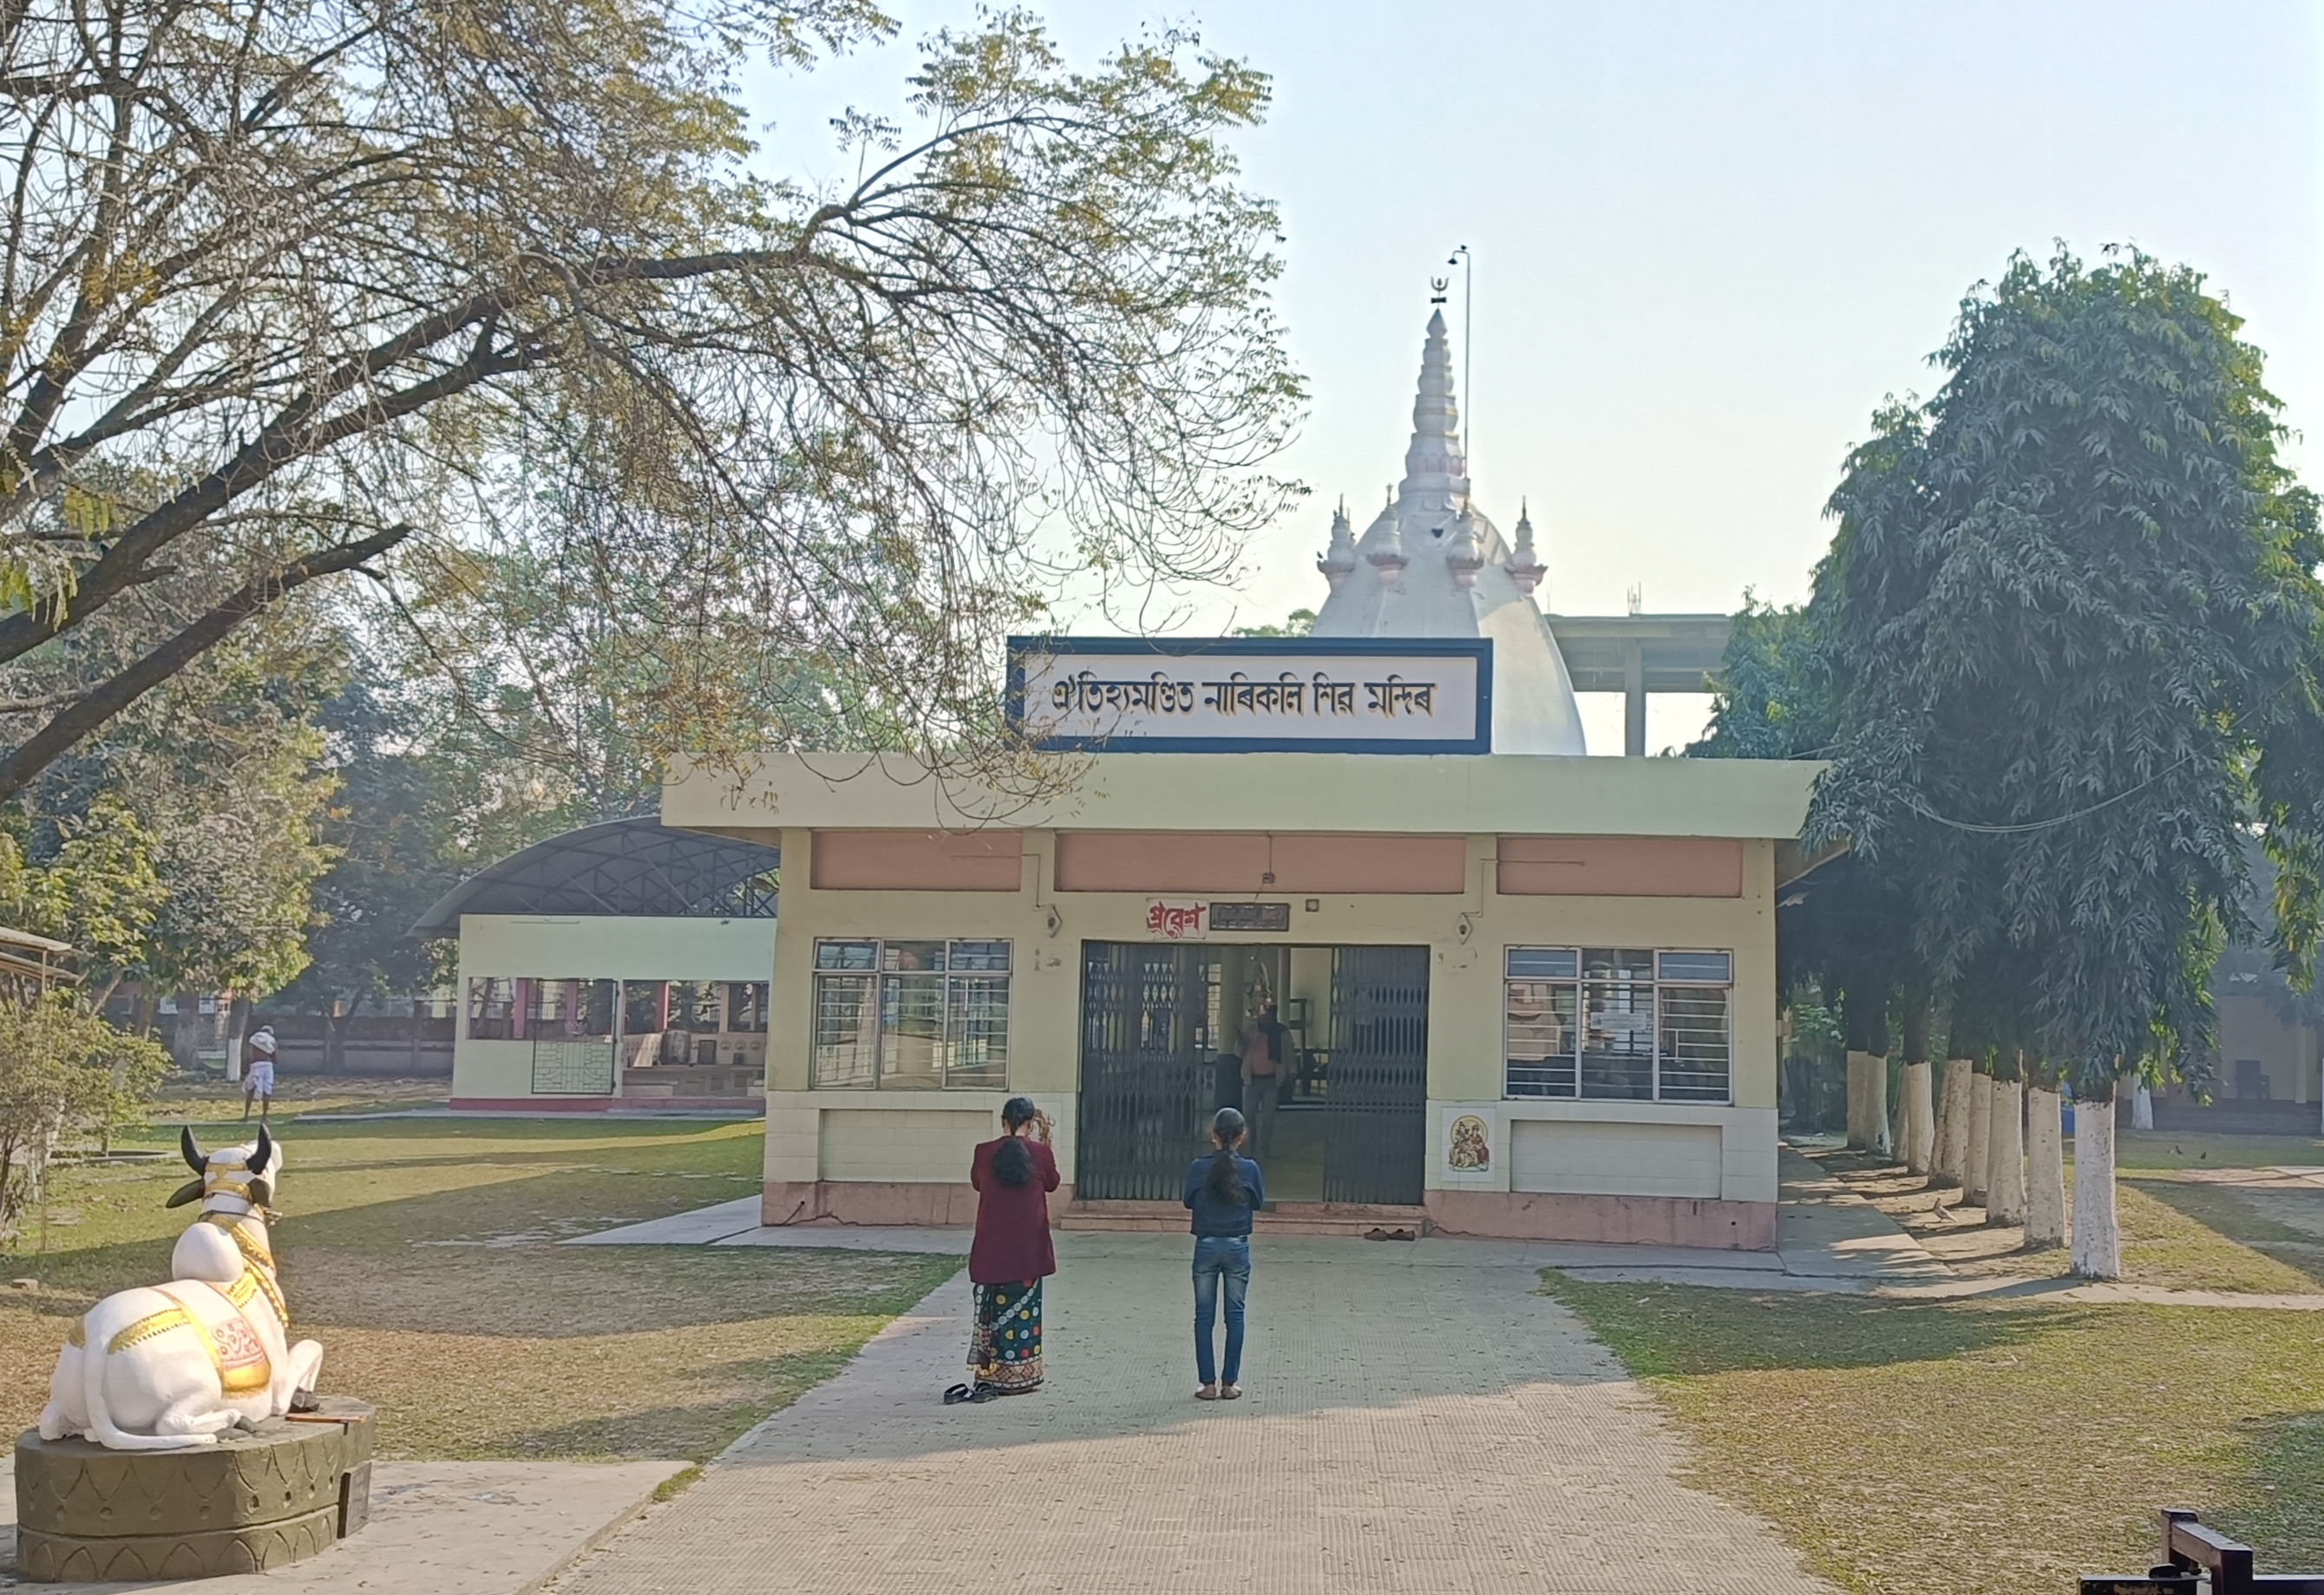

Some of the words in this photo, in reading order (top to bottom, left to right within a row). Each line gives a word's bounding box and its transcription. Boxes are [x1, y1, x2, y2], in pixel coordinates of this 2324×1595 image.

[1201, 671, 1306, 716] নাৰিকলি
[1313, 671, 1355, 716] শিৱ
[1364, 674, 1436, 716] মন্দিৰ
